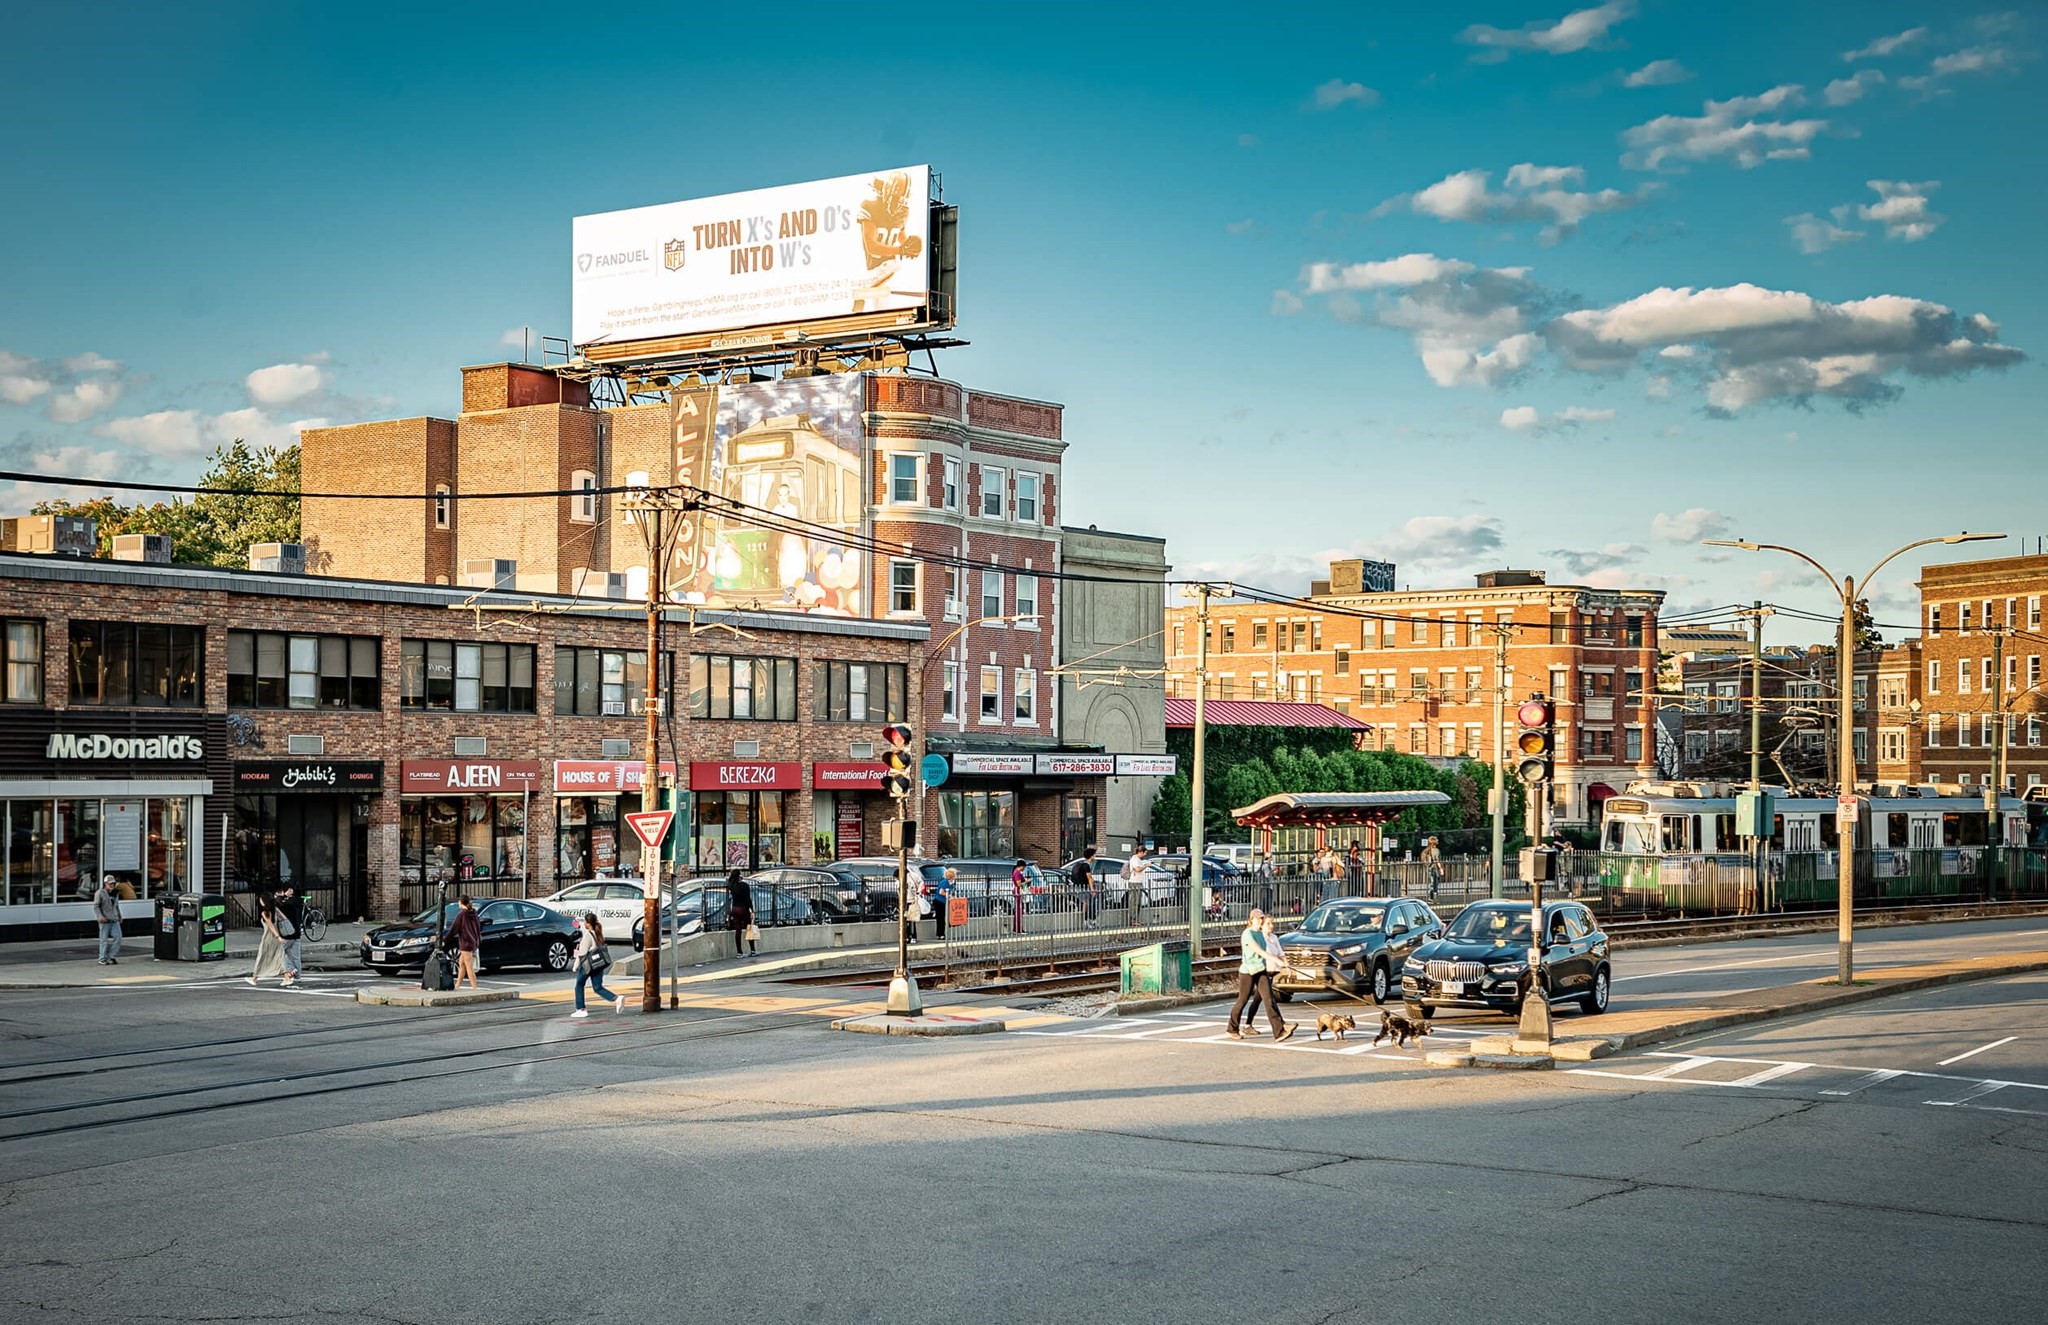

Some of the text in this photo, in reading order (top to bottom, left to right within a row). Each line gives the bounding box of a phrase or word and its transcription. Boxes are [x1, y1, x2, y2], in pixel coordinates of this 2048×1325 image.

[693, 205, 850, 250] TURN X's AND O's
[595, 249, 649, 268] FANDUEL
[666, 252, 683, 268] NFL
[730, 241, 811, 275] INTO W's
[621, 317, 641, 328] smart
[642, 315, 659, 325] from
[660, 313, 671, 322] the
[746, 542, 767, 552] 1211
[47, 734, 203, 759] McDonald's
[282, 765, 336, 787] Habibi's
[447, 765, 500, 787] AJEEN
[720, 766, 776, 784] BEREZKA
[822, 770, 867, 780] International
[1053, 763, 1111, 772] 617-286-3830
[562, 771, 611, 783] HOUSE OF
